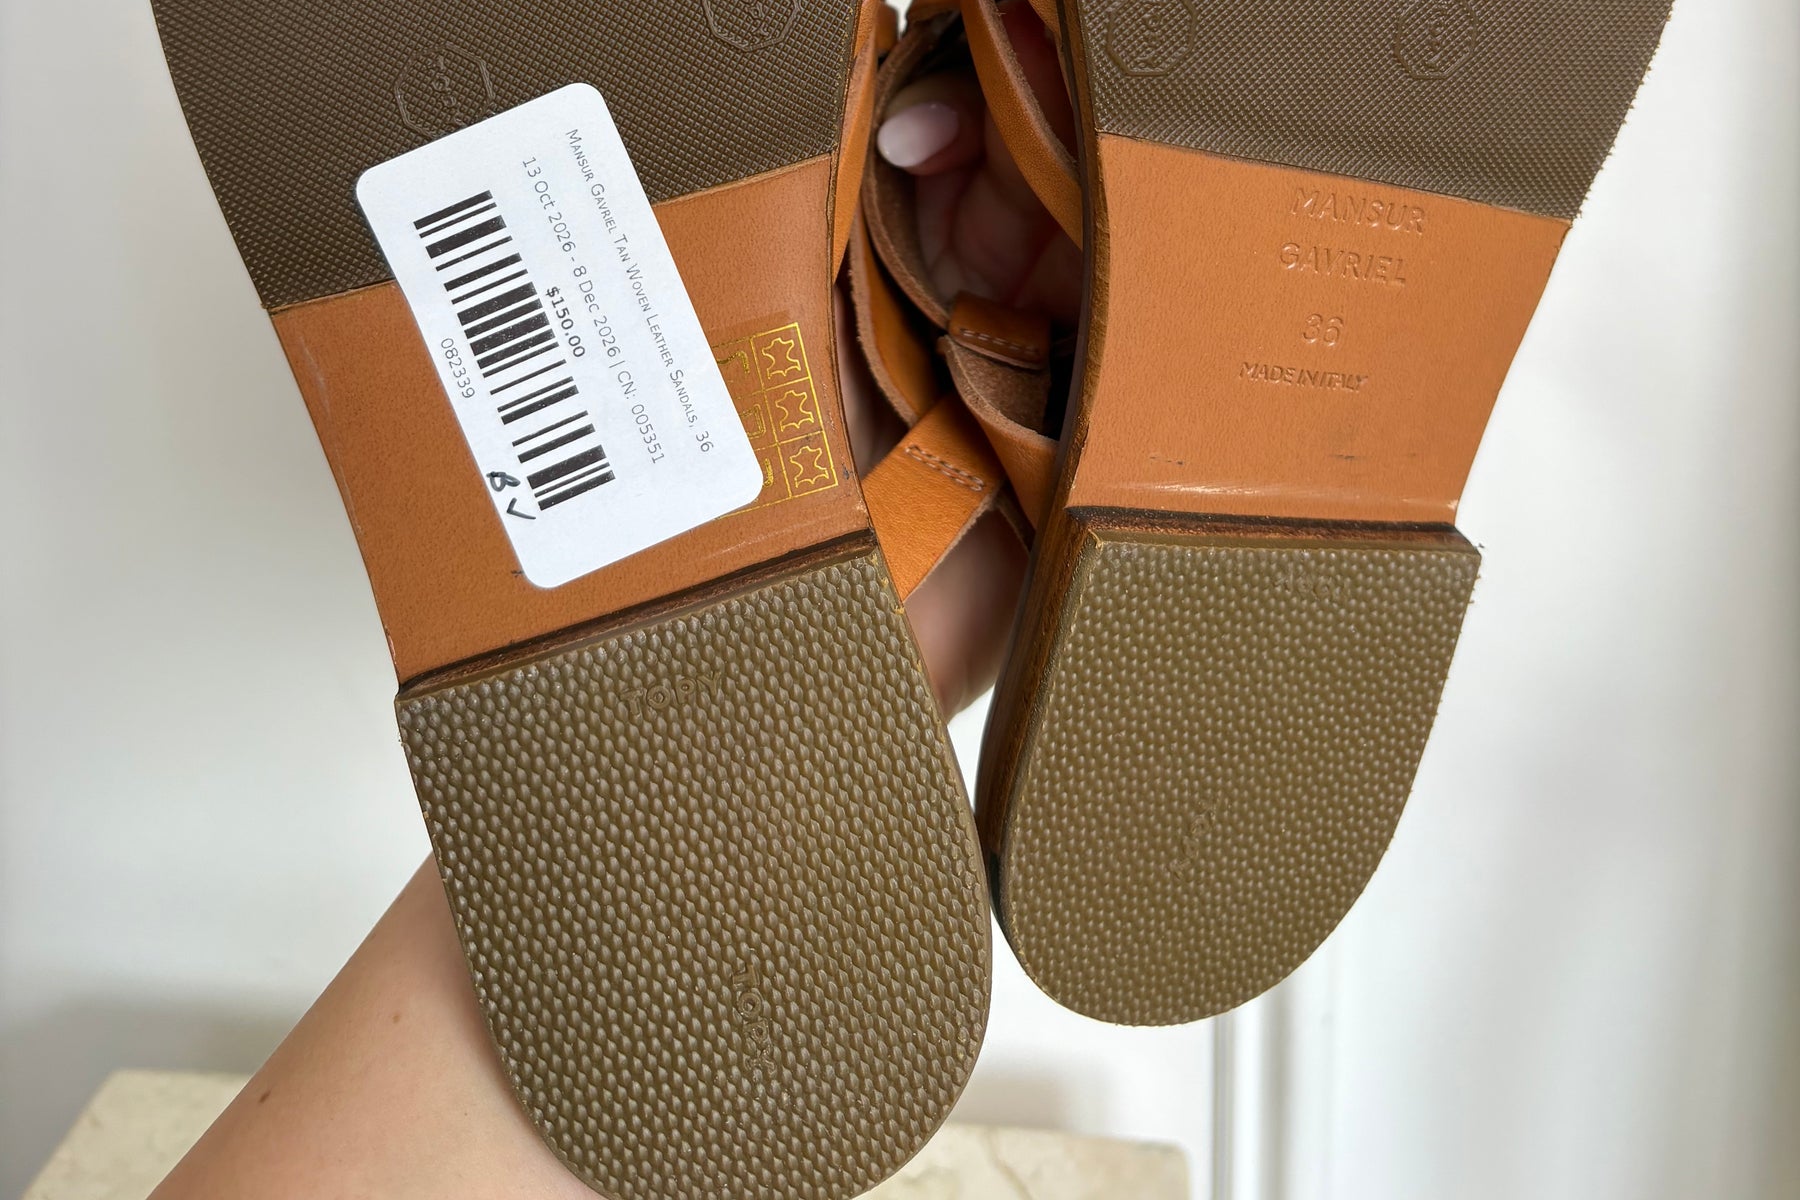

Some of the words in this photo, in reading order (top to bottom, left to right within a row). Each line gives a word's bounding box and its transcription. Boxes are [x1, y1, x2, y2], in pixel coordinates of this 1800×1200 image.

[522, 157, 542, 178] 13
[534, 180, 555, 210] Oct
[1290, 187, 1426, 235] MANSUR
[548, 212, 576, 253] 2026
[573, 265, 587, 278] 8
[1279, 242, 1406, 287] GAVRIEL
[579, 280, 600, 313] Dec
[545, 286, 586, 358] $150.00
[593, 315, 621, 358] 2026
[1302, 313, 1345, 348] 36
[440, 337, 476, 399] 082339
[617, 370, 637, 400] CN:
[631, 404, 665, 464] 005351
[695, 431, 714, 453] 36
